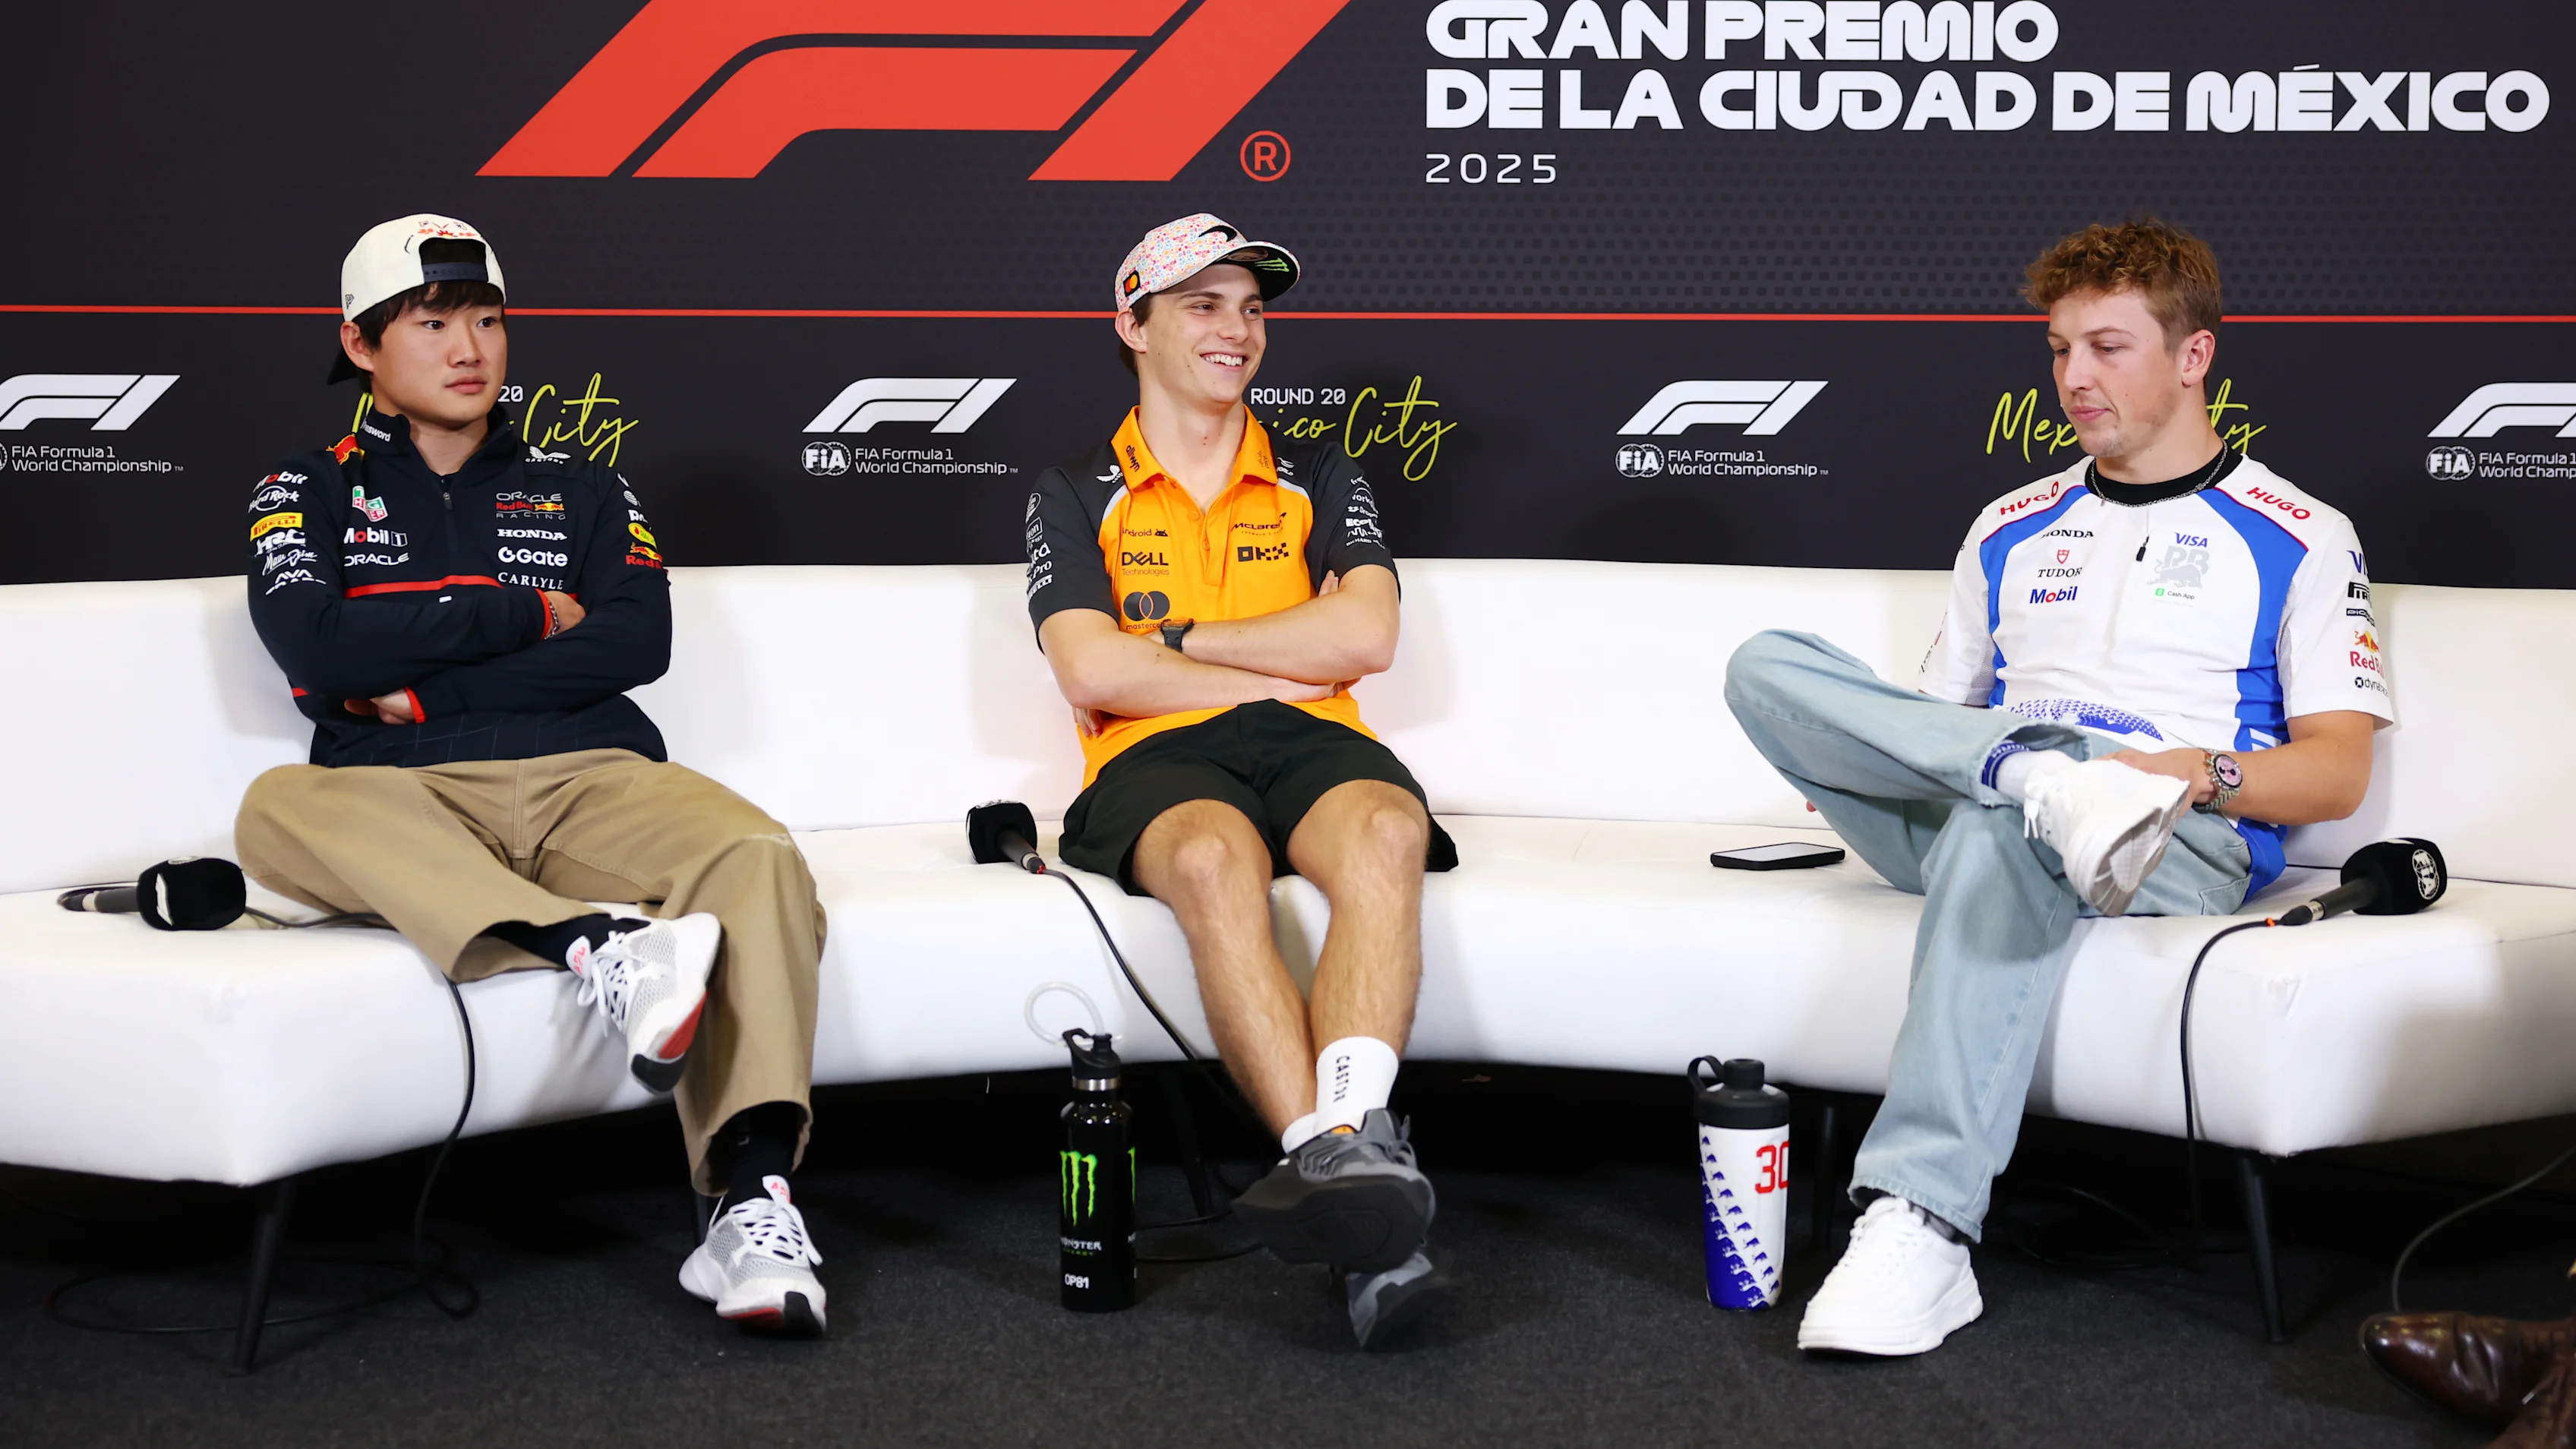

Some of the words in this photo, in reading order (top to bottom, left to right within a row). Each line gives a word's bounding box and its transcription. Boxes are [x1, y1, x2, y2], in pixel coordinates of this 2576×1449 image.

[1425, 0, 1689, 60] GRAN
[1704, 0, 2059, 62] PREMIO
[1425, 69, 1543, 130] DE
[1560, 69, 1684, 130] LA
[1699, 69, 2037, 131] CIUDAD
[2052, 71, 2170, 131] DE
[2186, 64, 2550, 133] MÉXICO
[1425, 153, 1557, 185] 2025
[1251, 388, 1314, 405] ROUND
[1321, 388, 1346, 405] 20
[522, 371, 639, 468] City
[1344, 374, 1457, 481] City
[1986, 388, 2078, 463] Mex
[2206, 378, 2267, 454] ty
[12, 445, 37, 458] FIA
[40, 445, 104, 458] Formula
[106, 445, 115, 458] 1
[855, 448, 879, 460] FIA
[882, 448, 943, 460] Formula
[945, 448, 954, 460] 1
[1668, 450, 1692, 462] FIA
[1694, 450, 1754, 462] Formula
[1756, 450, 1765, 462] 1
[2480, 452, 2504, 464] FIA
[2507, 452, 2568, 464] Formula
[12, 459, 58, 472] World
[62, 459, 172, 474] Championship
[855, 462, 900, 475] World
[902, 462, 1008, 475] Championship
[1668, 463, 1711, 476] World
[1714, 463, 1818, 478] Championship
[2480, 466, 2524, 478] World
[496, 491, 563, 503] ORACLE
[2000, 481, 2059, 516] HUGO
[2246, 487, 2310, 519] HUGO
[497, 529, 568, 541] HONDA
[2174, 532, 2208, 548] VISA
[1122, 551, 1169, 567] DELL
[1237, 542, 1290, 562] OKX
[1122, 568, 1170, 577] Technologies
[497, 572, 564, 590] CARLYLE
[2029, 586, 2078, 604] Mobil
[1126, 622, 1162, 630] masterc
[2350, 651, 2376, 671] Red
[1064, 1272, 1090, 1290] OP81
